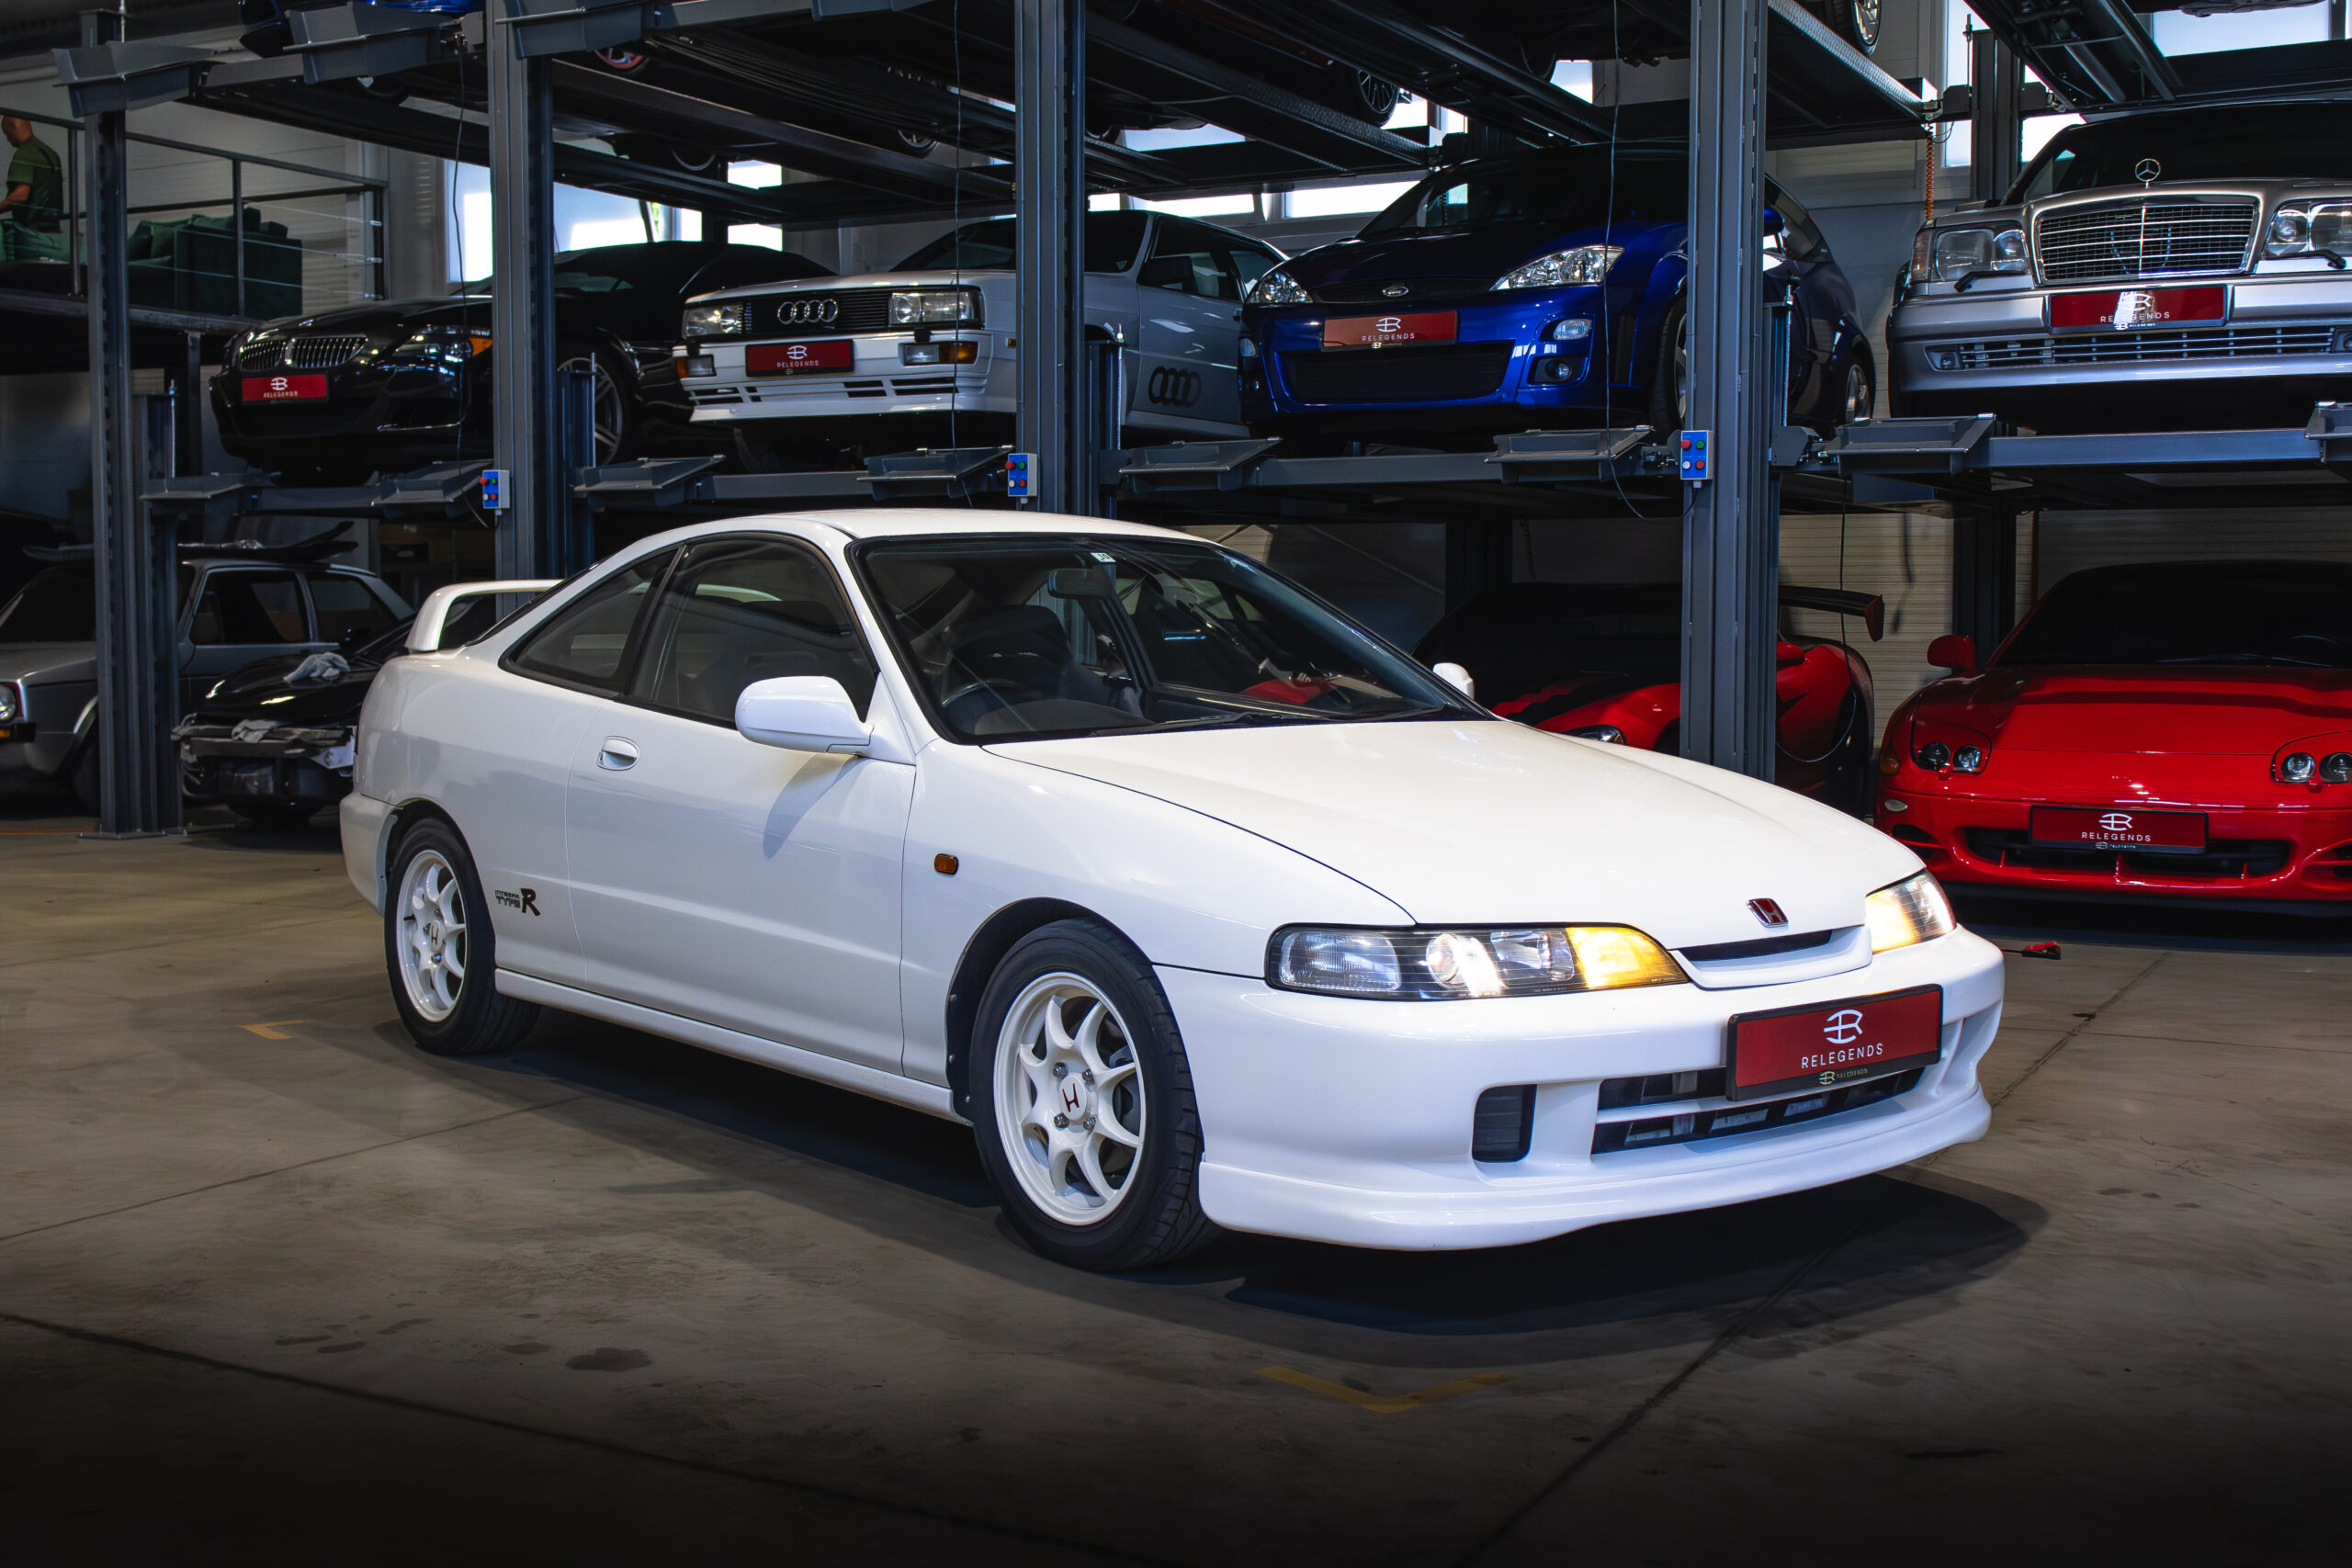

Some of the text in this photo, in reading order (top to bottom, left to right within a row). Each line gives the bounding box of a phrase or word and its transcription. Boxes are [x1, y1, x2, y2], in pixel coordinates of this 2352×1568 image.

[1362, 333, 1415, 342] RELEGENDS
[776, 360, 820, 368] RELEGENDS
[2081, 831, 2152, 842] RELEGENDS
[520, 887, 541, 917] R
[1801, 1043, 1883, 1069] RELEGENDS
